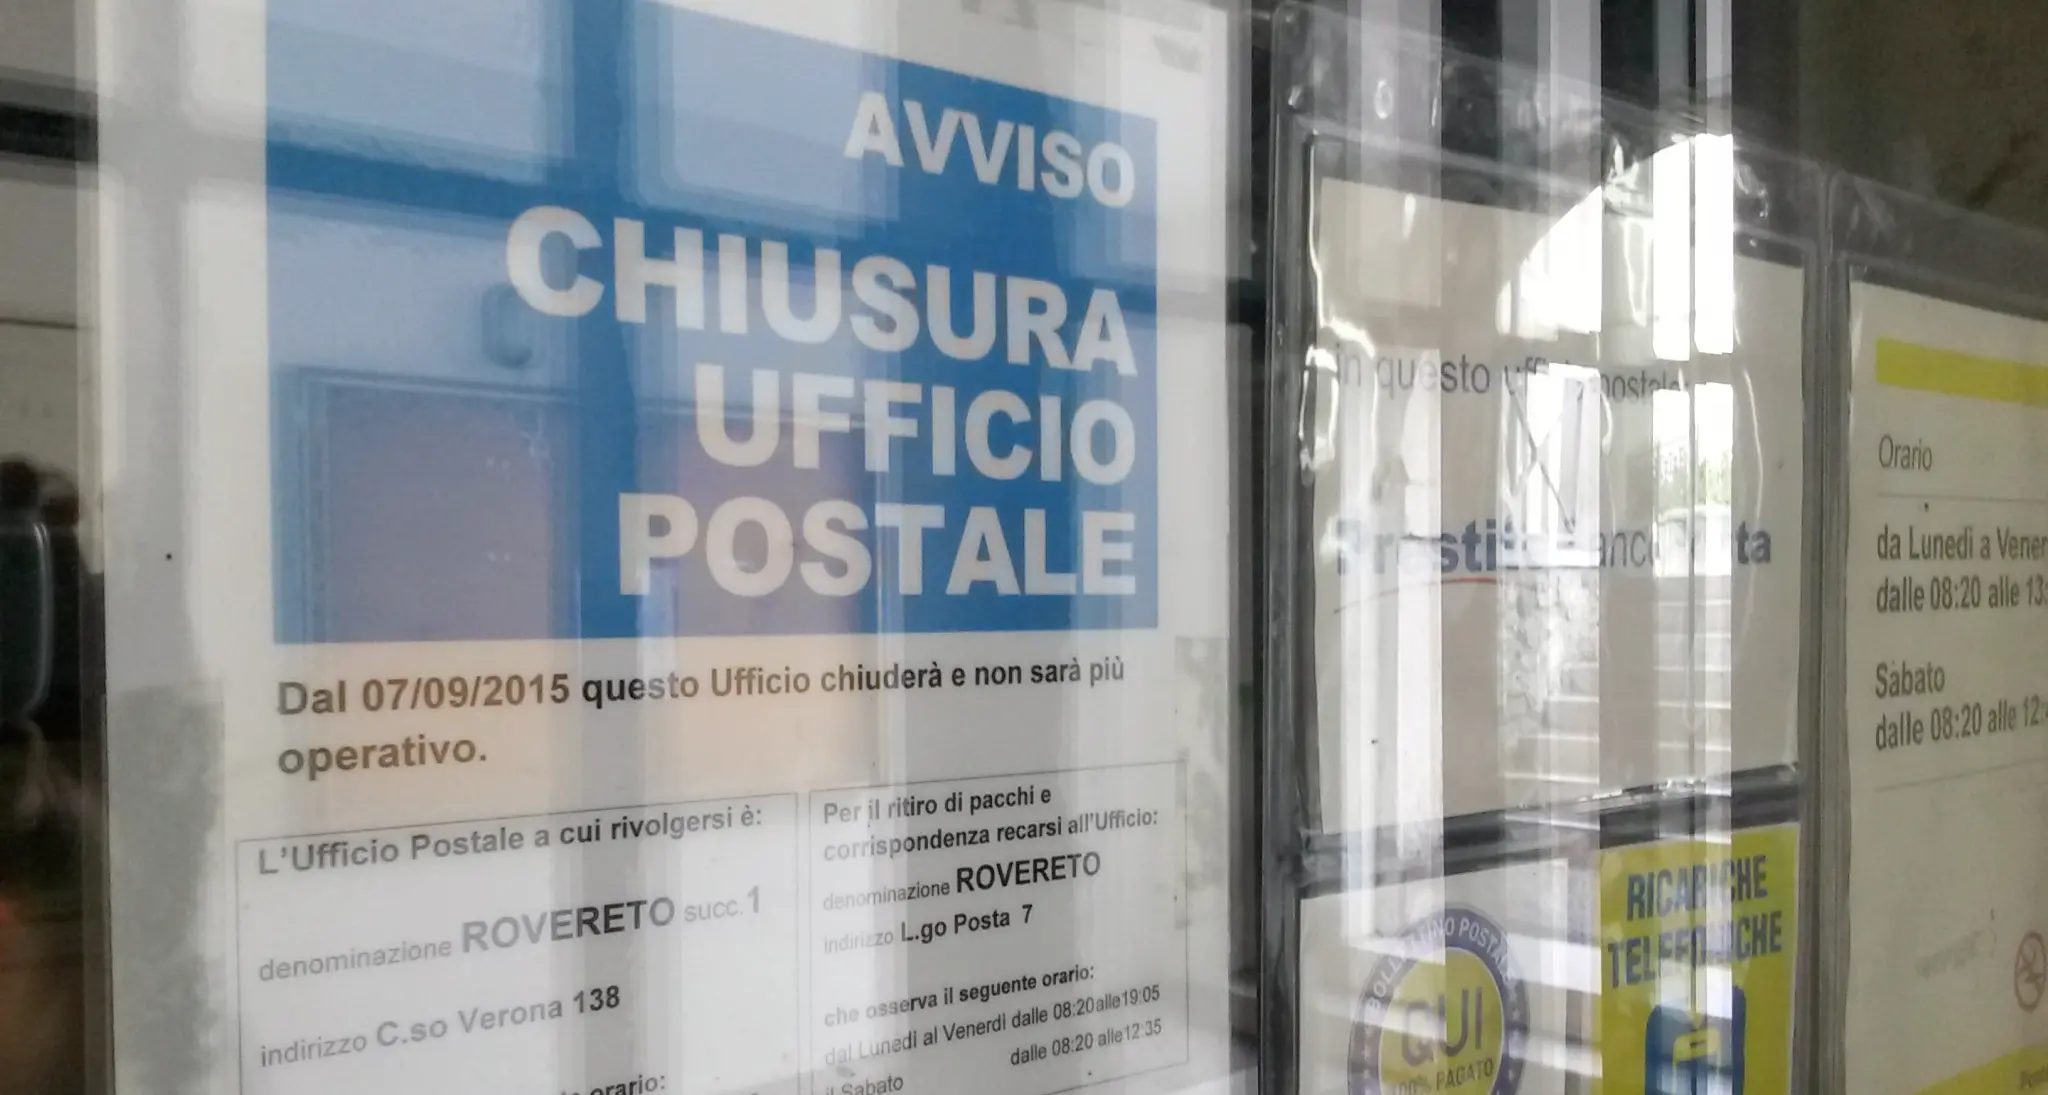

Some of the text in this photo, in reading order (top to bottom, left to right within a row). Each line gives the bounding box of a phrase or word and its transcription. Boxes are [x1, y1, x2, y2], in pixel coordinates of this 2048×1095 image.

[844, 91, 1135, 207] AVVISO
[506, 205, 1137, 375] CHIUSURA
[1338, 342, 1361, 388] in
[1377, 354, 1490, 399] questo
[696, 365, 1135, 484] UFFICIO
[1879, 434, 1932, 471] Orario
[619, 493, 1137, 597] POSTALE
[1877, 524, 1901, 560] da
[1980, 537, 1990, 560] a
[1877, 576, 1924, 613] dalle
[1930, 576, 1981, 611] 08:20
[1988, 575, 2020, 608] alle
[277, 655, 1125, 716] Dal 07/09/2015 questo Ufficio chiuderà e non sarà più
[1875, 661, 1945, 699] Sabato
[1876, 711, 1923, 750] dalle
[1930, 702, 1982, 741] 08:20
[1988, 698, 2017, 733] alle
[278, 735, 487, 781] operativo.
[824, 786, 1051, 824] Per il ritiro di pacchi e
[258, 804, 762, 875] L'Ufficio Postale a cui rivolgersi è:
[824, 823, 990, 862] corrispondenza
[997, 816, 1062, 843] recarsi
[823, 851, 1101, 912] denominazione ROVERETO
[259, 938, 453, 982] denominazione
[462, 896, 675, 954] ROVERETO
[824, 904, 1034, 954] indirizzo L.go Posta 7
[824, 964, 1095, 1028] che osserva il seguente orario:
[261, 985, 620, 1067] indirizzo C.so Verona 138
[825, 1043, 852, 1067] dal
[923, 1026, 939, 1046] al
[1011, 1006, 1049, 1030] dalle
[1010, 1018, 1163, 1067] dalle 08:20 alle 12:35
[1436, 1058, 1494, 1091] PAGATO
